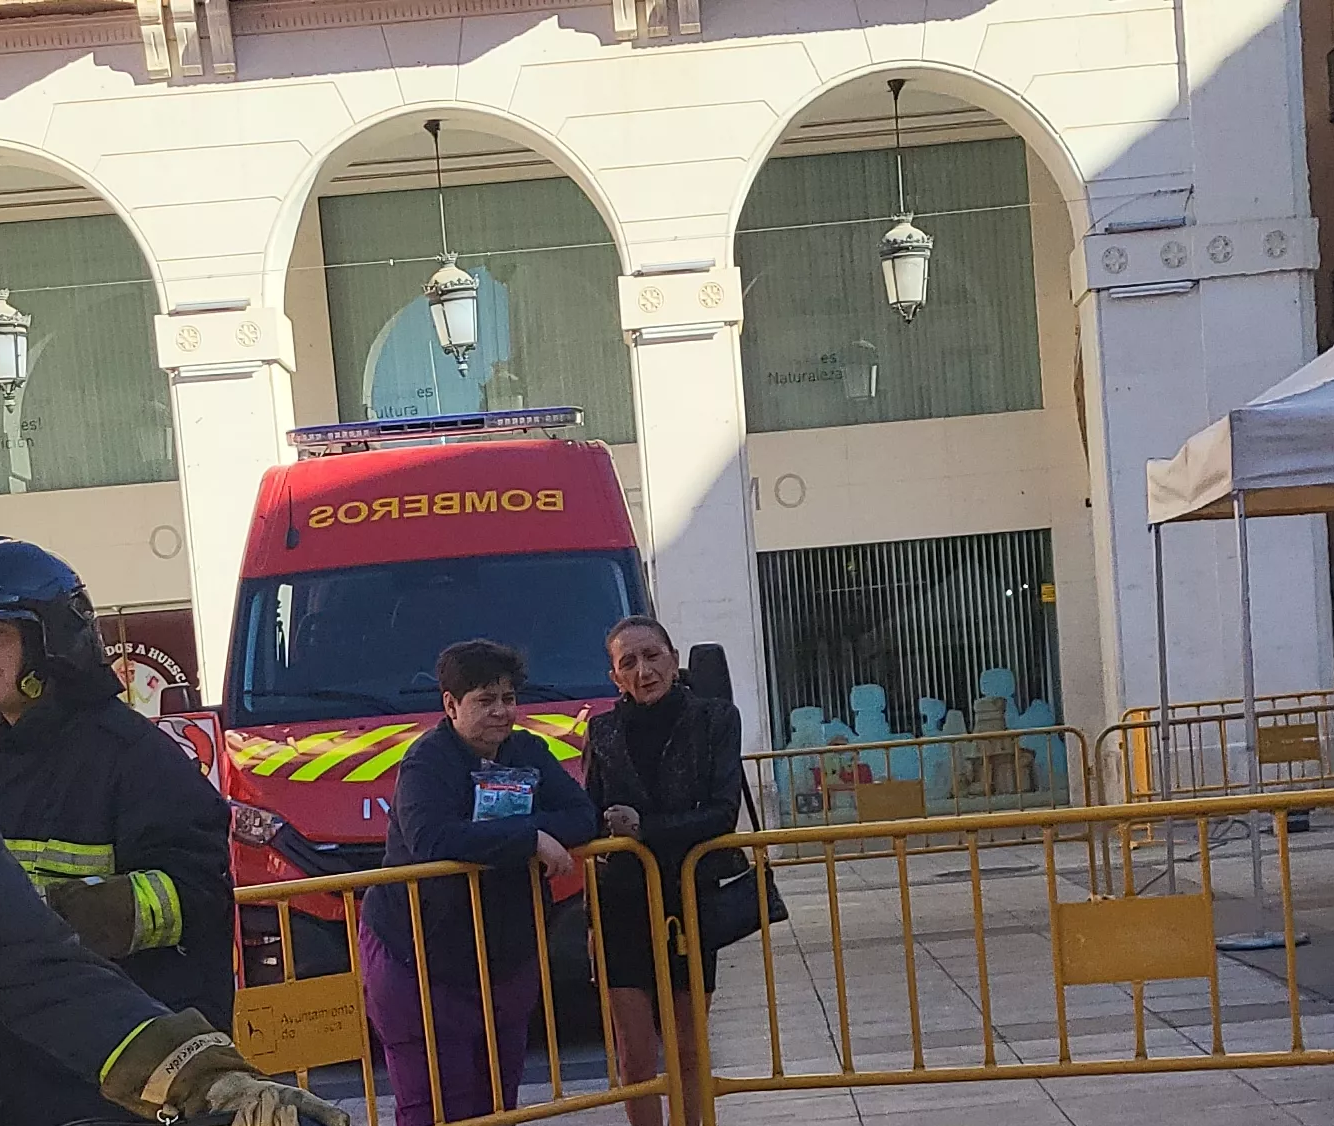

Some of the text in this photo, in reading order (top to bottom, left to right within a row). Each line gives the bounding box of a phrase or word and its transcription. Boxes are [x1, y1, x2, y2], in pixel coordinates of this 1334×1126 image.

[768, 369, 843, 385] Naturaleza
[417, 387, 434, 398] es
[147, 647, 187, 683] HUESC
